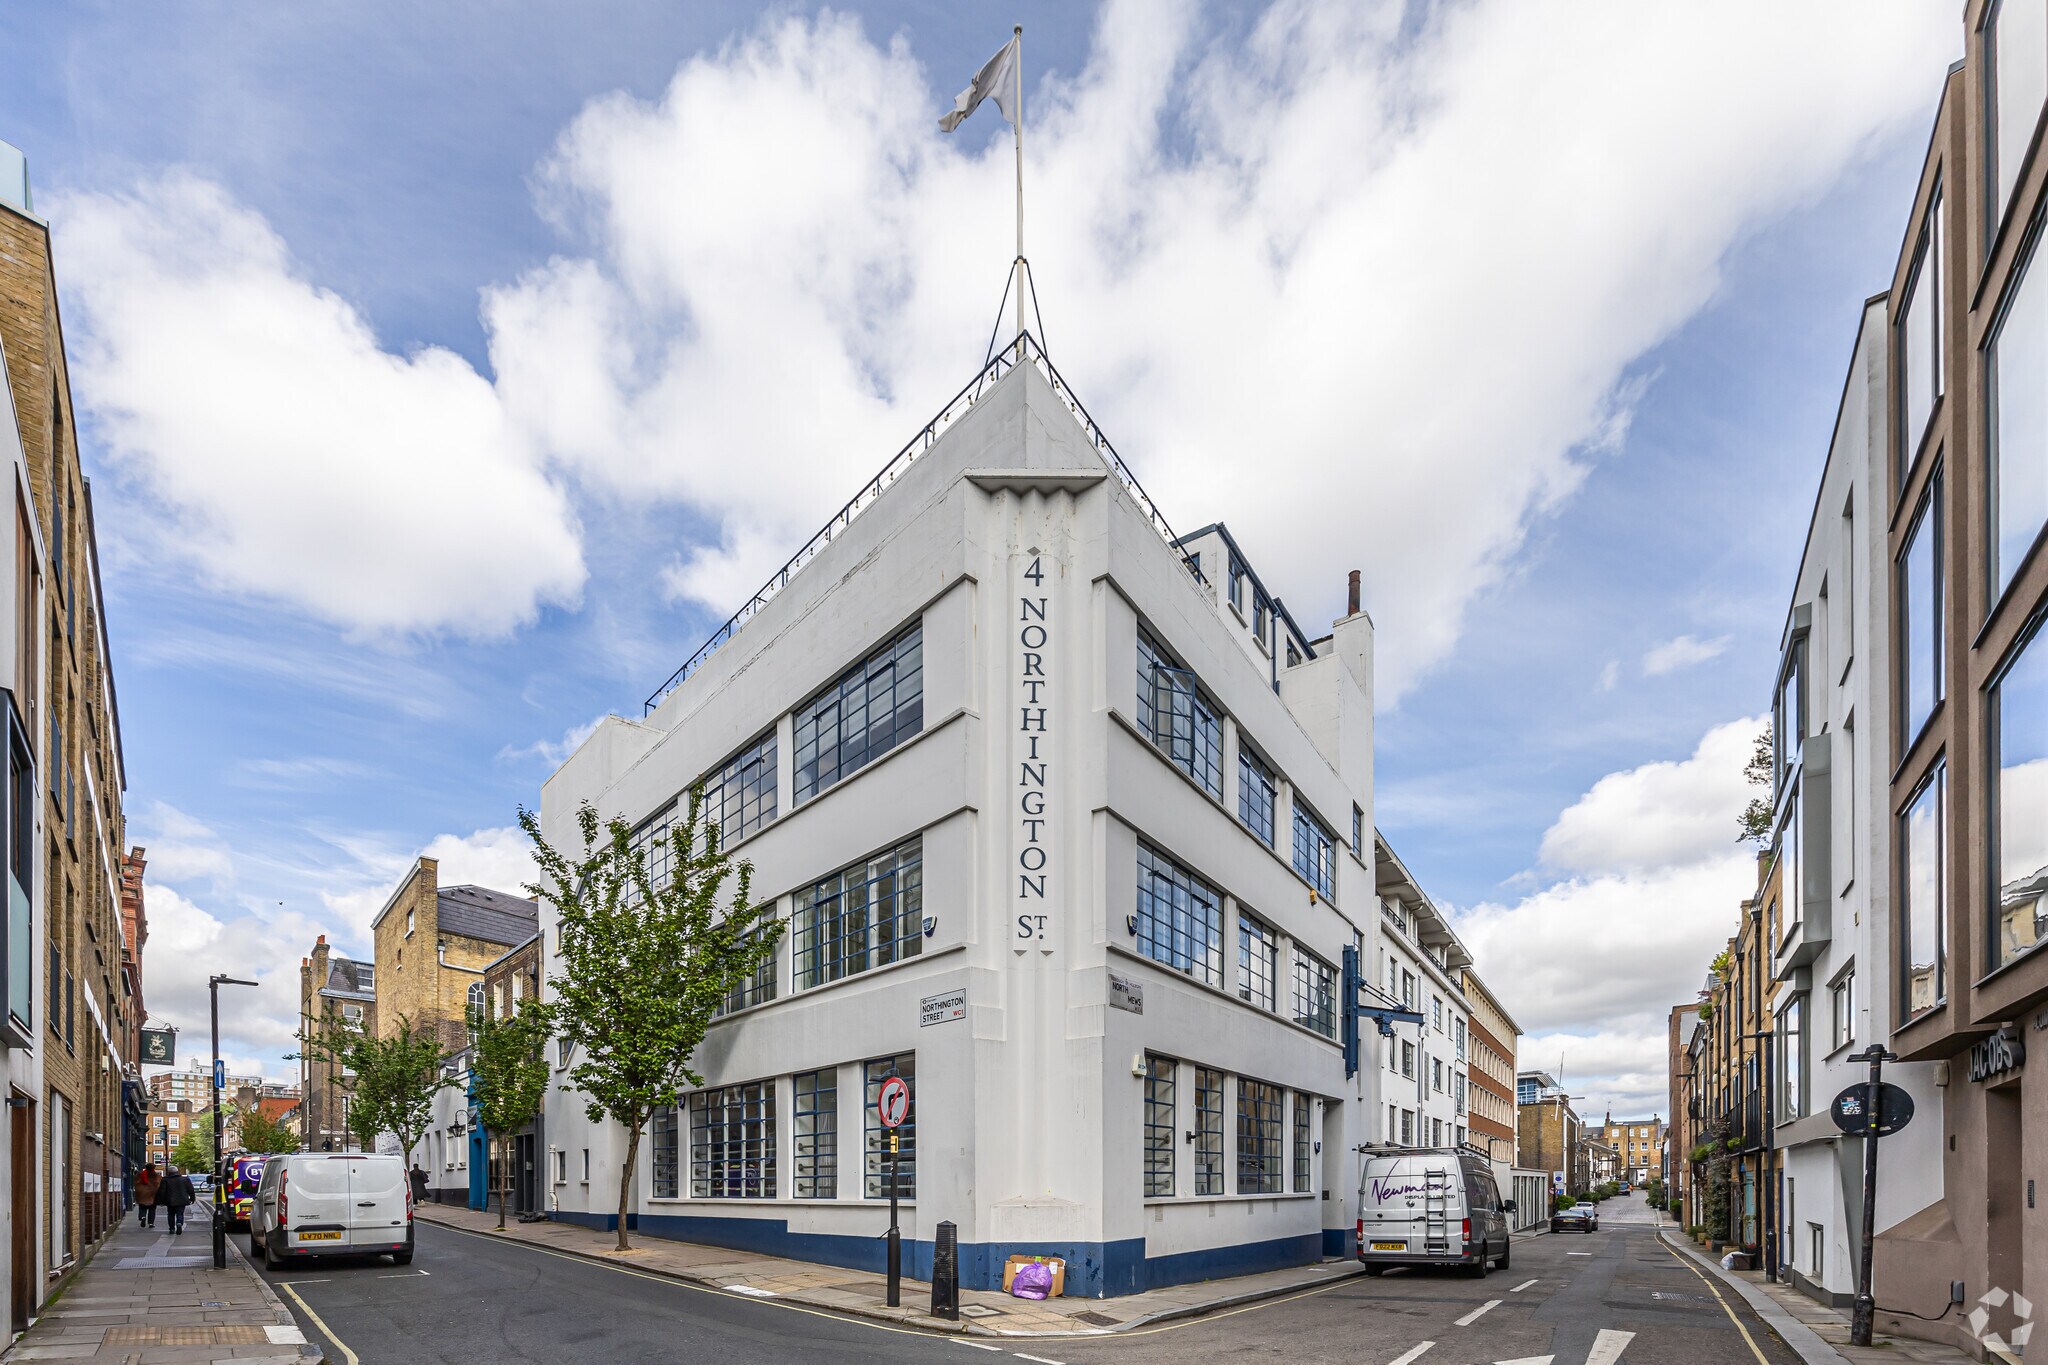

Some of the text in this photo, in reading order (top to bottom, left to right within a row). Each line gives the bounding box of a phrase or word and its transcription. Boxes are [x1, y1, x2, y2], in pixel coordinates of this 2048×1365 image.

[1023, 556, 1045, 587] 4
[1019, 597, 1048, 899] NORTHINGTON
[1112, 981, 1129, 995] NORTH
[922, 996, 964, 1014] NORTHINGTON
[1127, 995, 1142, 1007] MEWS
[922, 1009, 964, 1023] STREET WC1
[1967, 1028, 2013, 1084] JACOBS
